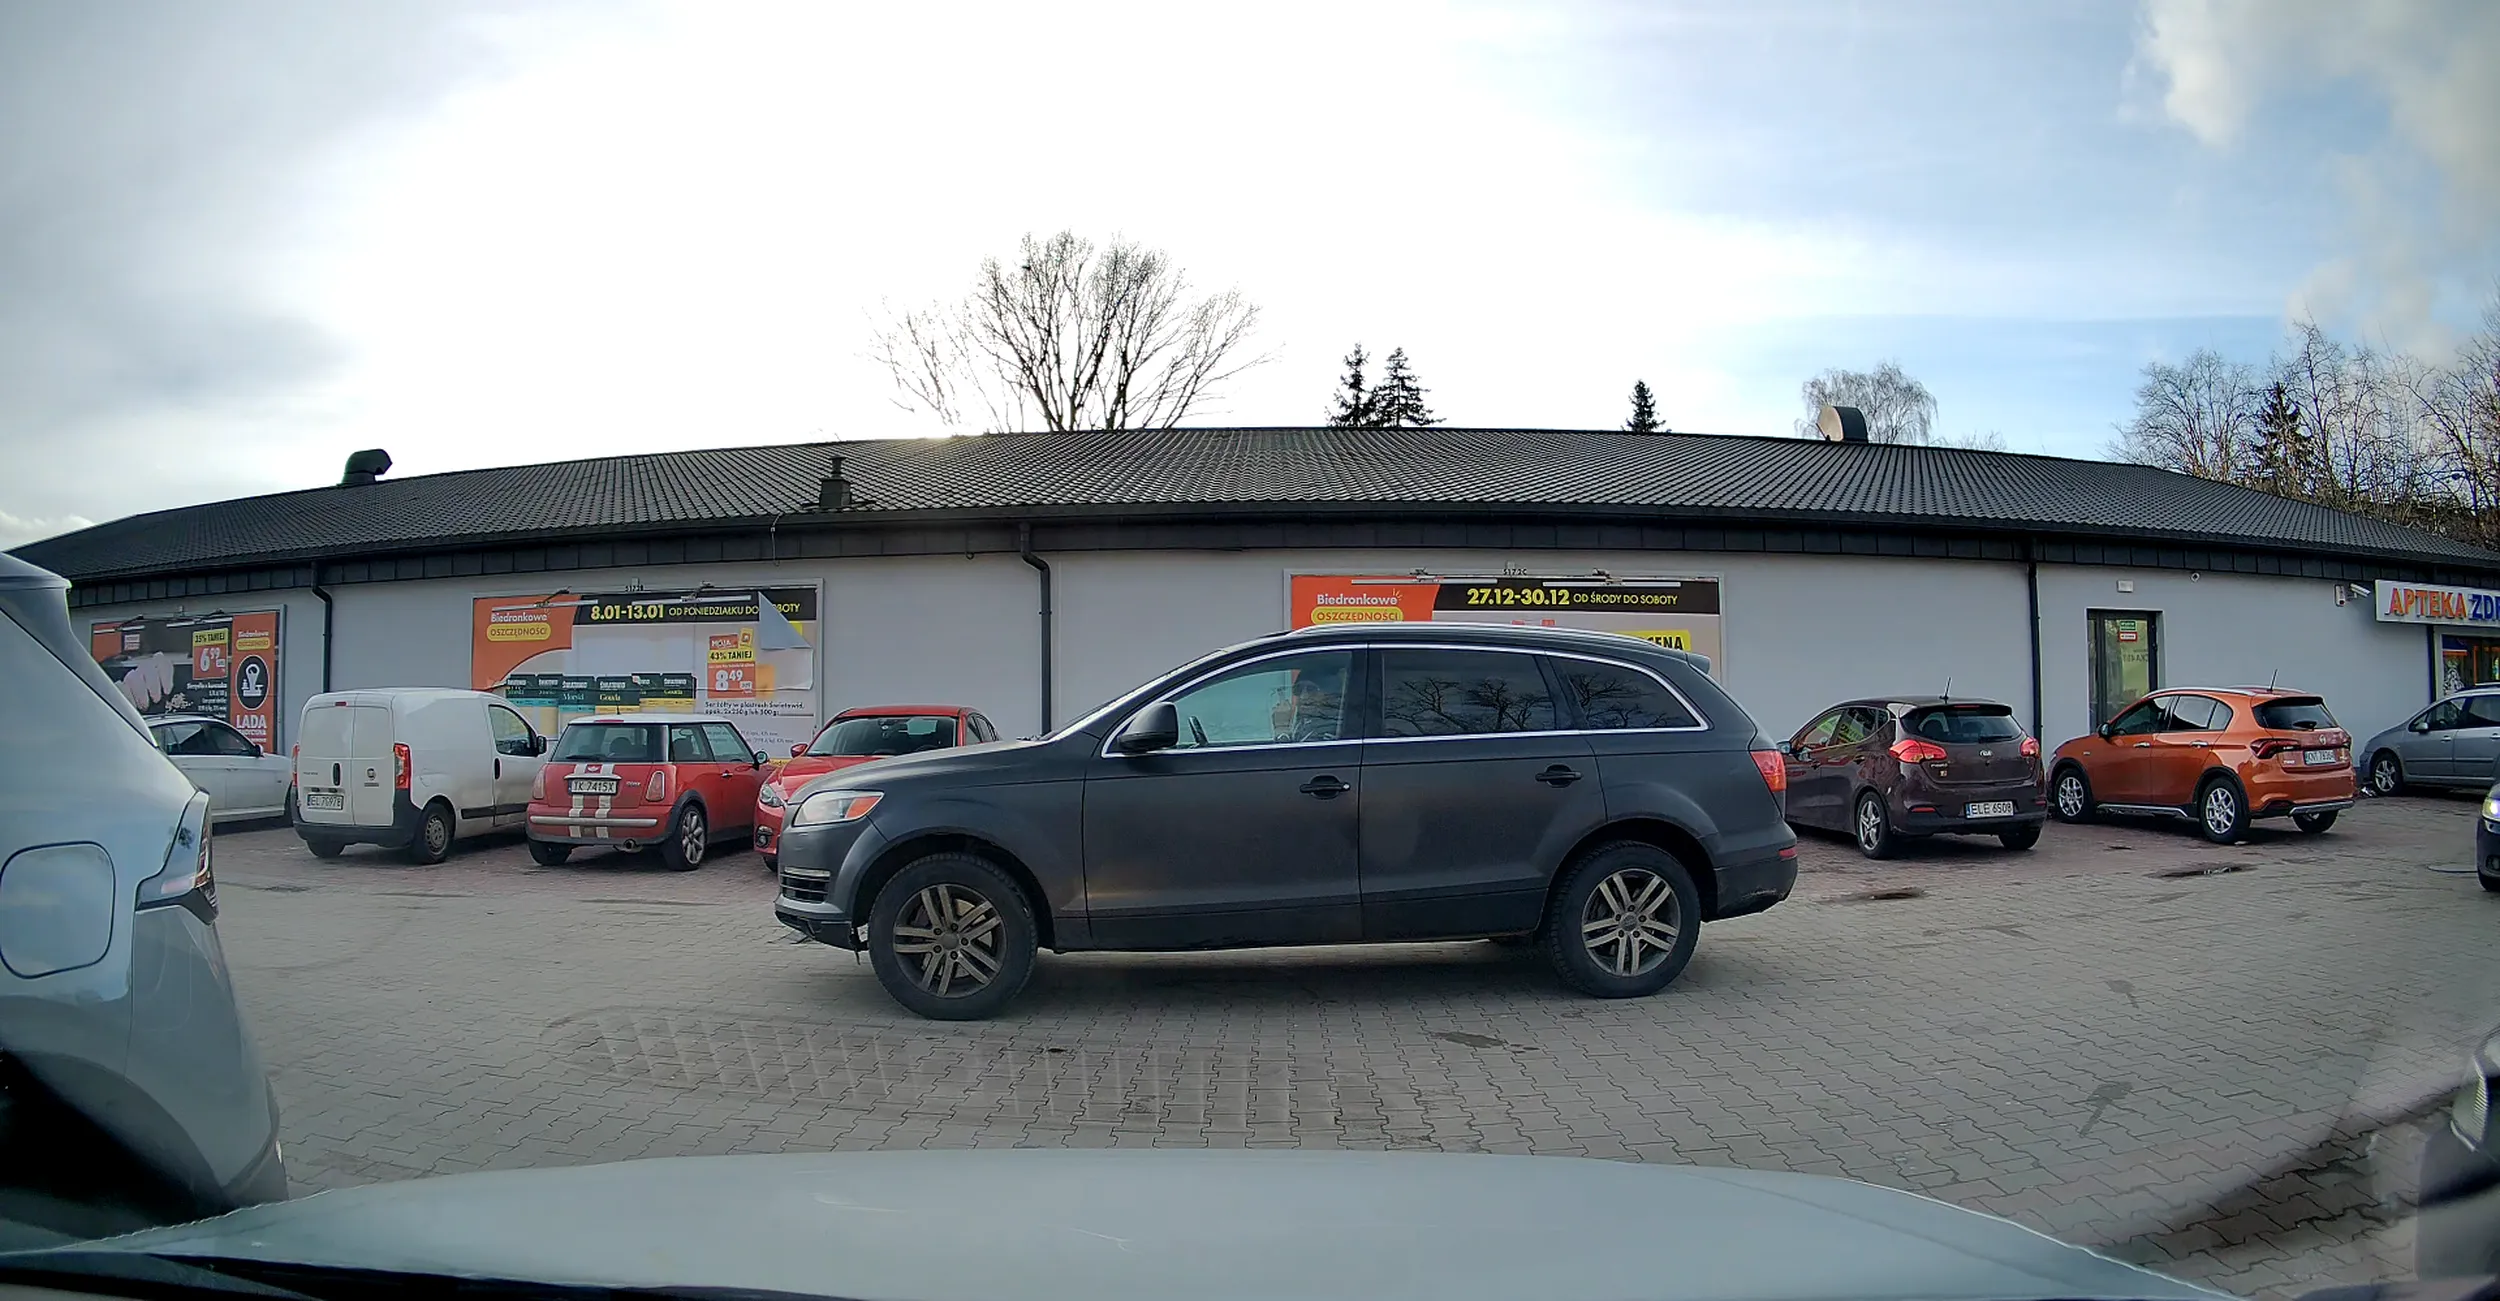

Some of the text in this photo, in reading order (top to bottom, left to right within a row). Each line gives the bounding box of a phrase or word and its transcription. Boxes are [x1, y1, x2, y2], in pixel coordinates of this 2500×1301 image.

[1317, 593, 1398, 605] Biedronkowe
[1467, 588, 1678, 605] 27.12-30.12 OD ŚRODY DO SOBOTY
[2389, 587, 2467, 618] APTEKA
[491, 612, 548, 622] Biedronkowe
[590, 604, 664, 620] 8.01-13.01
[669, 607, 682, 616] OD
[683, 604, 744, 616] PONIEDZIAŁKU
[745, 606, 759, 615] DO
[1317, 610, 1399, 622] OSZCZĘDNOŚCI
[490, 627, 547, 638] OSZCZĘDNOŚCI
[1647, 636, 1684, 650] ENA
[200, 647, 210, 671] 6
[710, 651, 752, 660] 43% TANIEJ
[715, 669, 743, 690] 8 49
[236, 714, 267, 729] LADA
[1971, 803, 1991, 815] ELE
